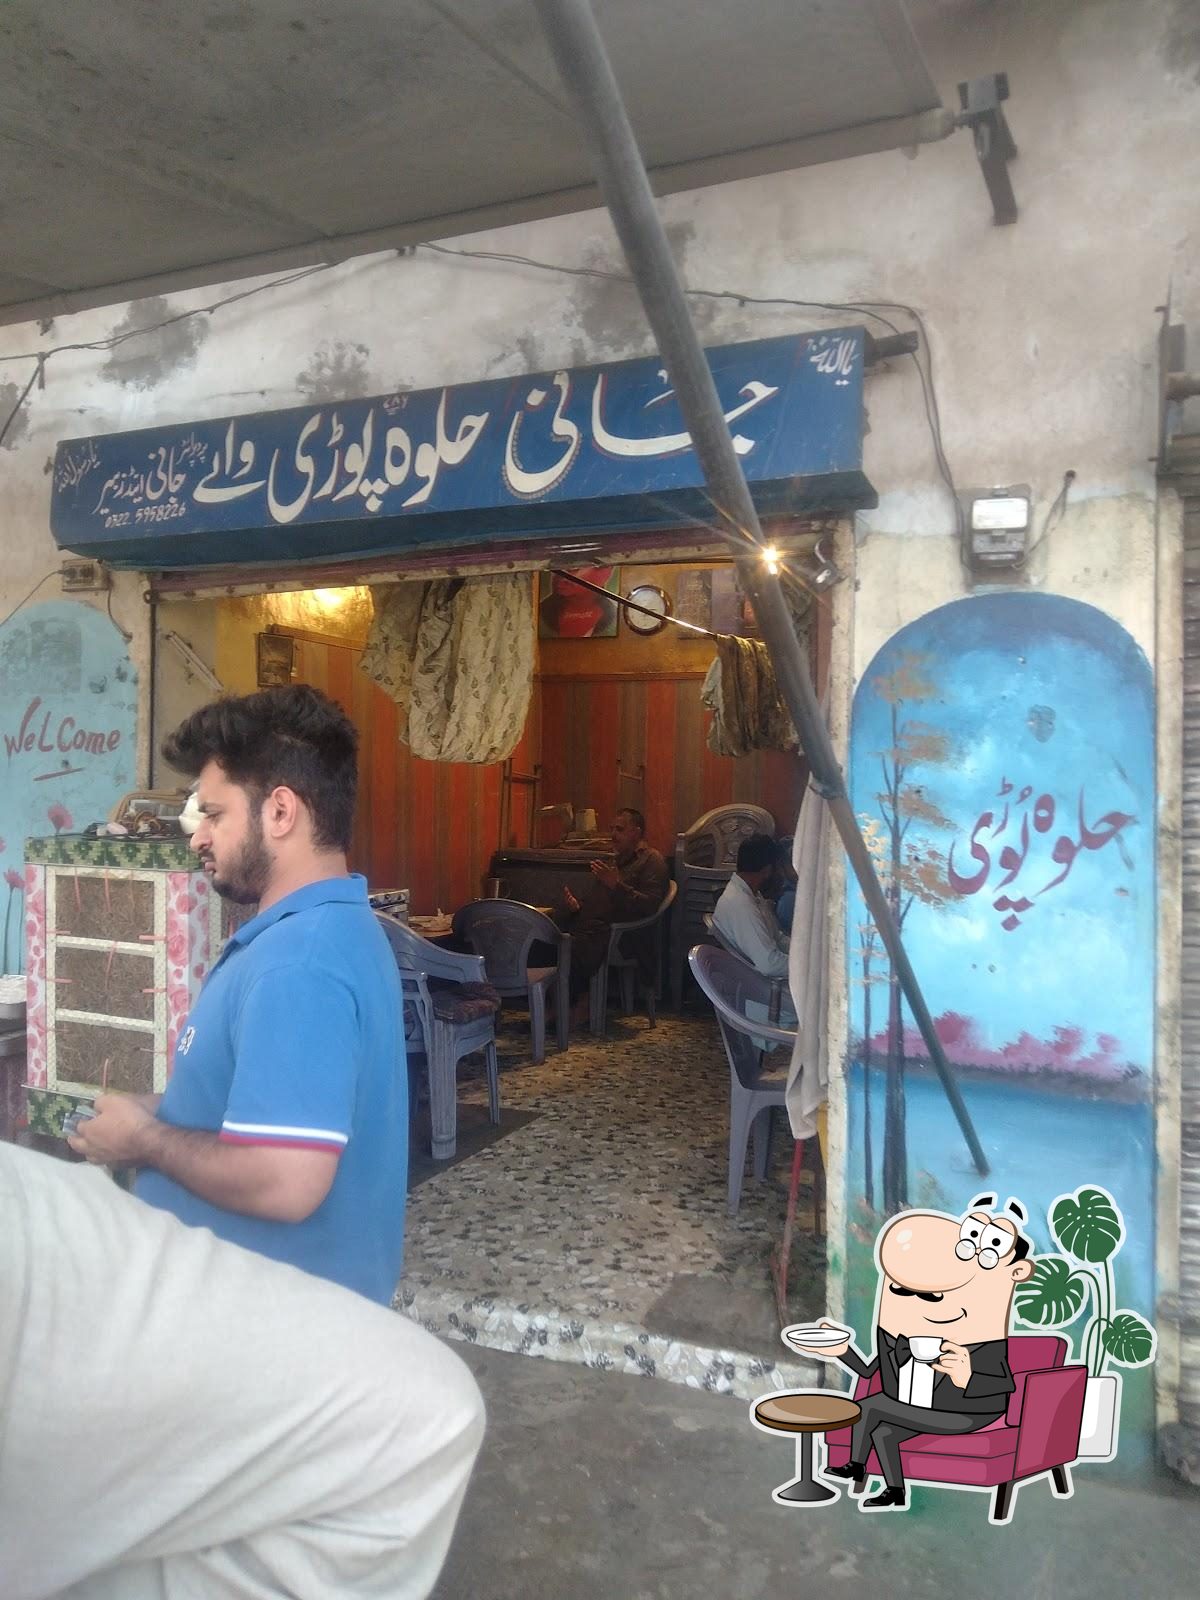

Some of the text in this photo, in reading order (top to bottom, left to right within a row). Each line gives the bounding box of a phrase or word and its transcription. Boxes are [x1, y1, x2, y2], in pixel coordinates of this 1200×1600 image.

[145, 446, 187, 504] جانی
[192, 419, 268, 504] والے
[386, 387, 491, 508] حلوہ
[1033, 783, 1138, 897] حلوہ
